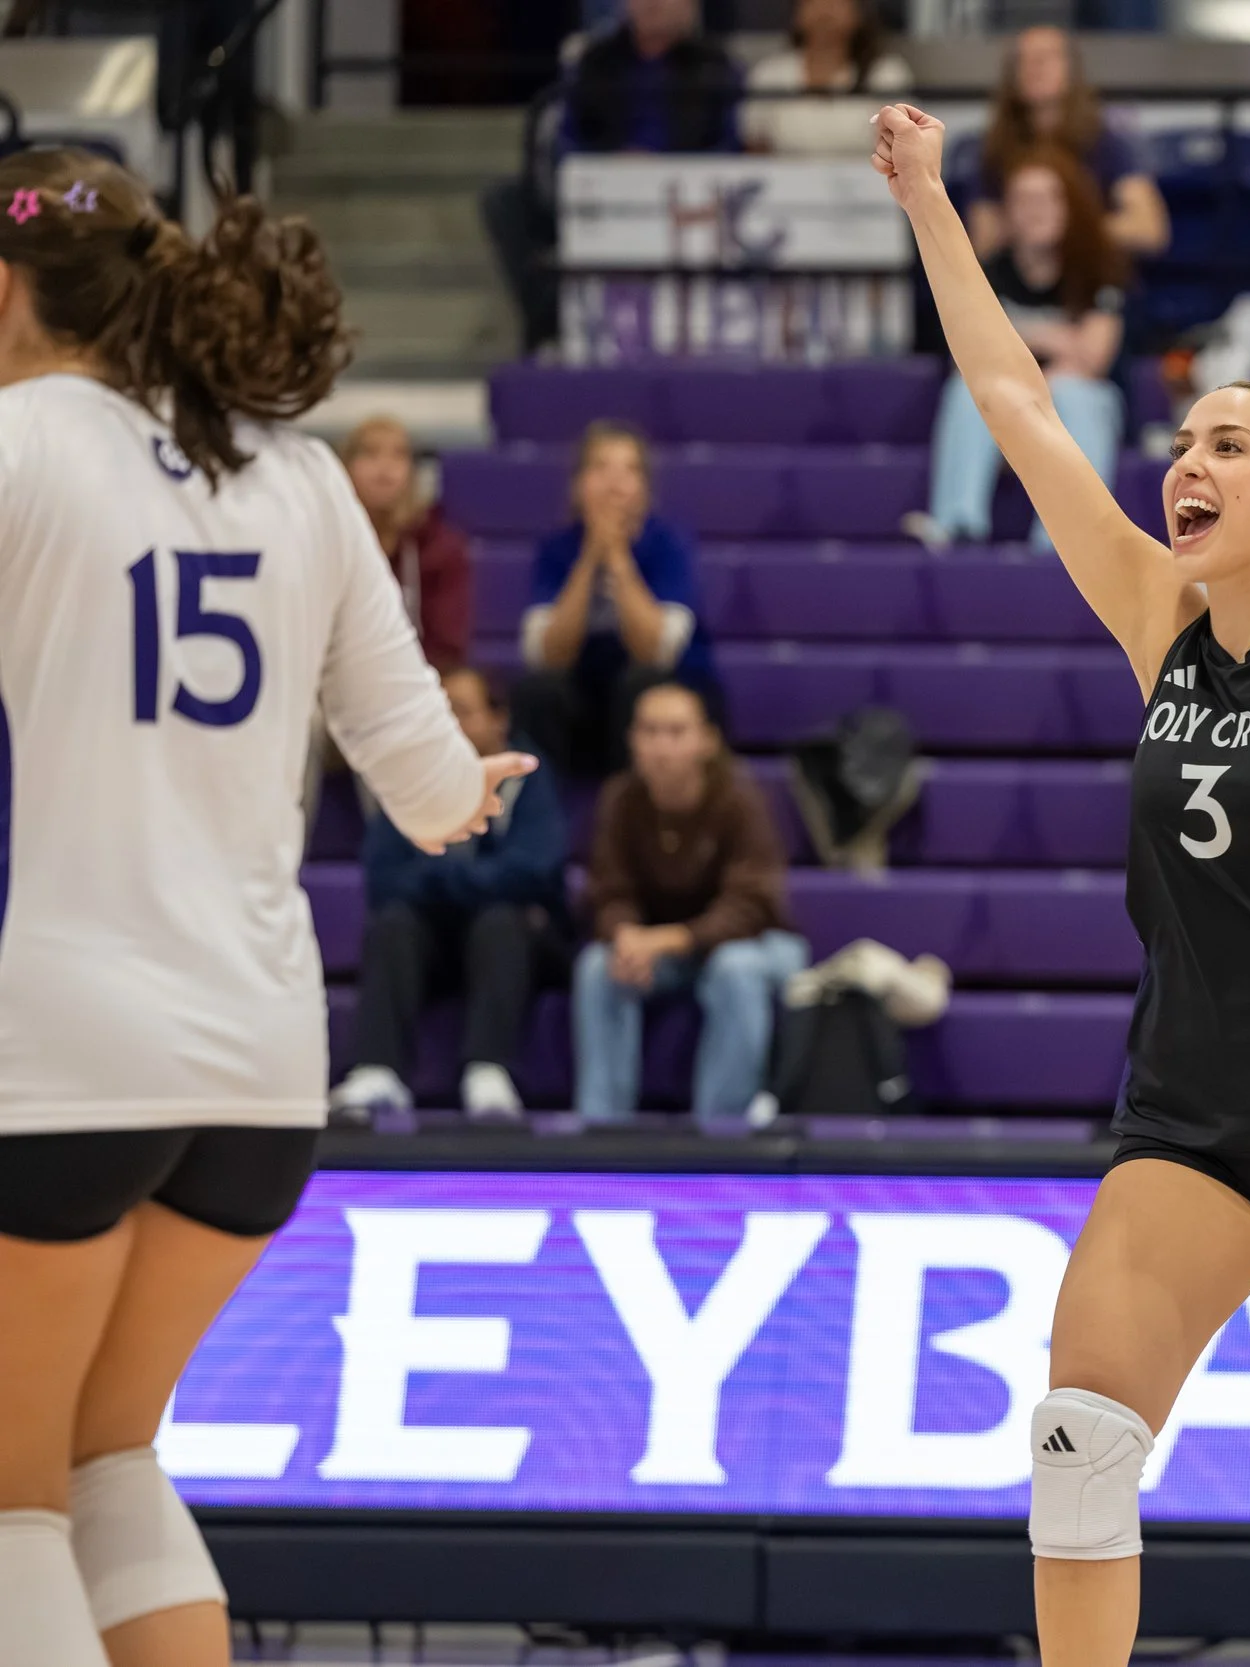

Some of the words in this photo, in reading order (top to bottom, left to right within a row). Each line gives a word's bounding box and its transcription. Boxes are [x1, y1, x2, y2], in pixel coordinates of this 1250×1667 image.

[127, 547, 262, 728] 15
[1140, 699, 1213, 744] OLY
[1180, 763, 1232, 859] 3
